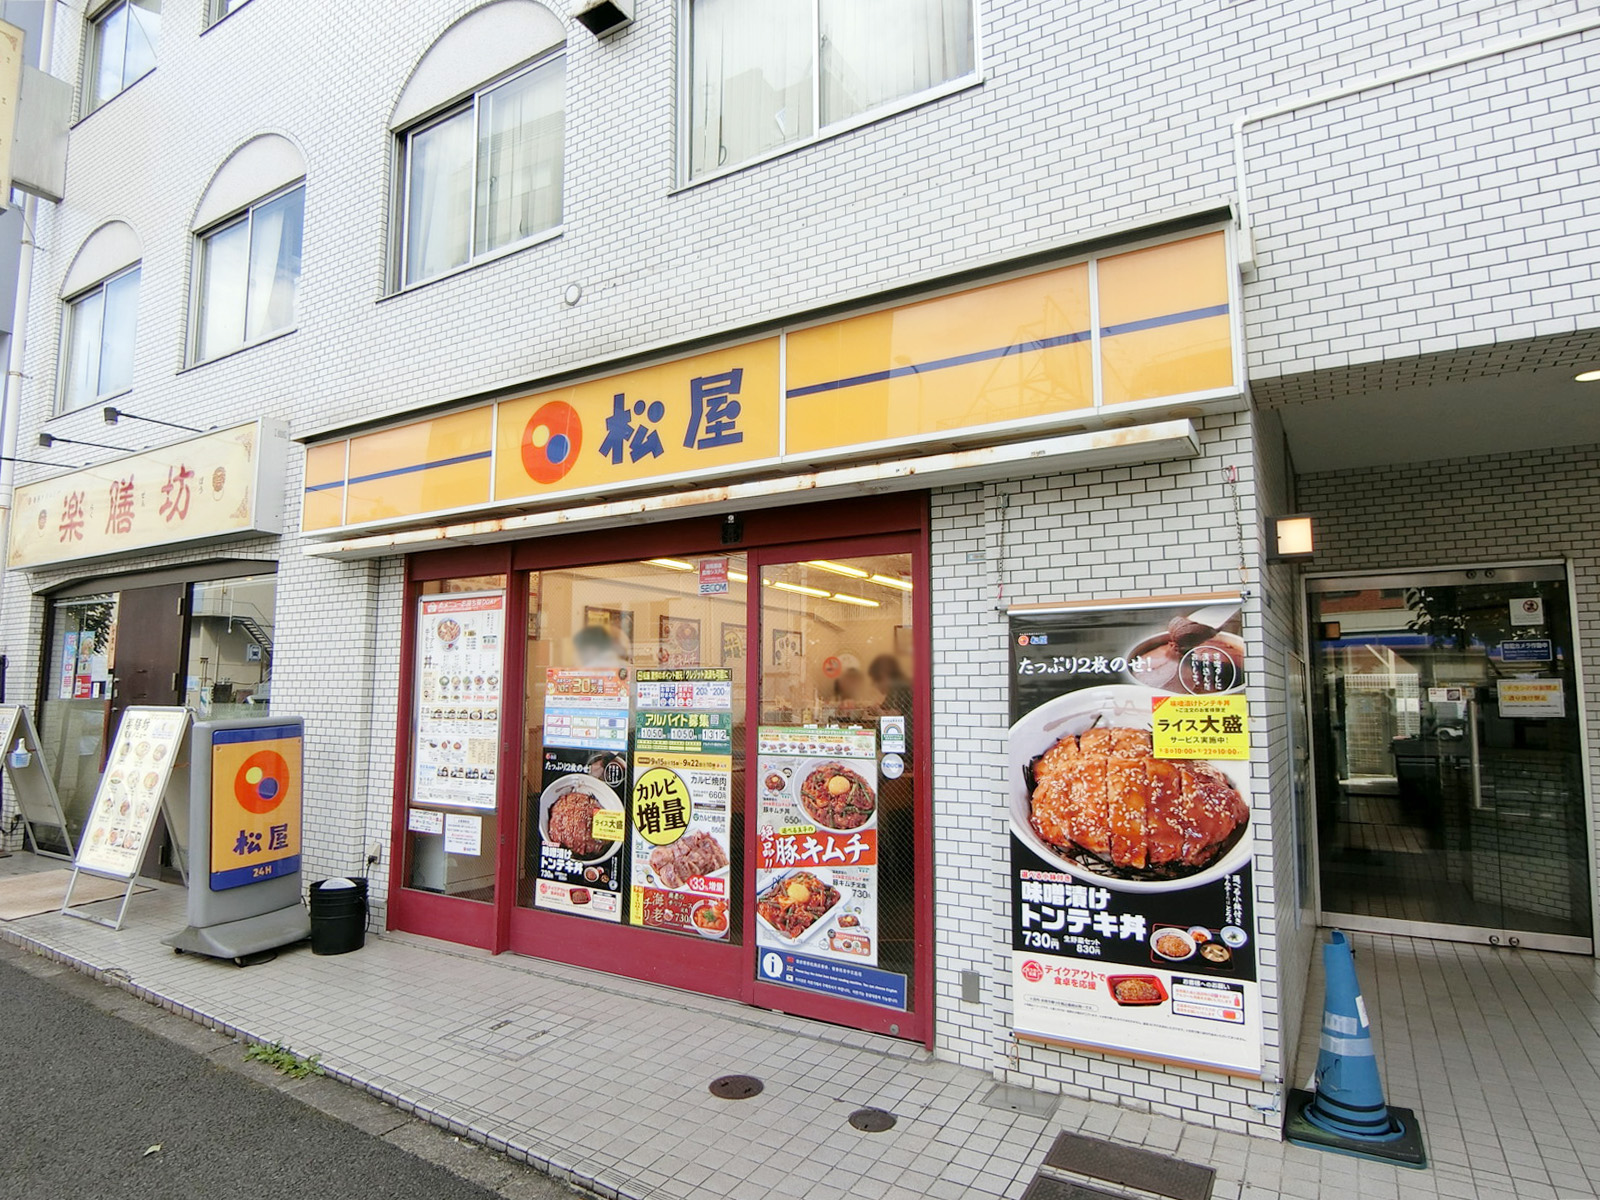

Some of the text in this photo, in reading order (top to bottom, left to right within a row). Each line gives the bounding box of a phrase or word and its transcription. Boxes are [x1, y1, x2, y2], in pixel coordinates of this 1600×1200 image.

[598, 367, 744, 465] 松屋
[58, 463, 195, 543] 楽膳坊
[701, 584, 727, 592] SECOM
[1018, 655, 1152, 676] たっぷり2枚のせ!
[645, 714, 709, 727] アルバイト募集
[1157, 714, 1243, 734] ライス大盛
[642, 728, 727, 740] 1050 1050 1312
[1170, 736, 1229, 744] サービス実施中!
[545, 761, 592, 773] たっぷり2枚のせ!
[690, 776, 727, 786] カルビ焼肉
[636, 774, 678, 802] カルビ
[709, 791, 726, 799] 660円
[637, 797, 688, 834] 増量
[595, 820, 623, 830] ライス大盛
[233, 823, 289, 856] 松屋
[775, 833, 870, 866] 豚キムチ
[253, 865, 272, 878] 24H
[541, 856, 584, 875] トンテキ丼
[1021, 870, 1072, 883] 選べる小鉢付き
[832, 879, 867, 889] 豚キムチ定食
[1021, 881, 1112, 910] 味噌漬け
[1020, 902, 1147, 943] トンテキ丼
[1022, 930, 1060, 950] 730円
[1063, 935, 1101, 946] 生野菜セット
[1076, 944, 1101, 955] 830円
[1045, 964, 1106, 981] テイクアウトで
[1054, 976, 1096, 990] 食卓を応援
[1182, 979, 1231, 990] お客様へのお願い
